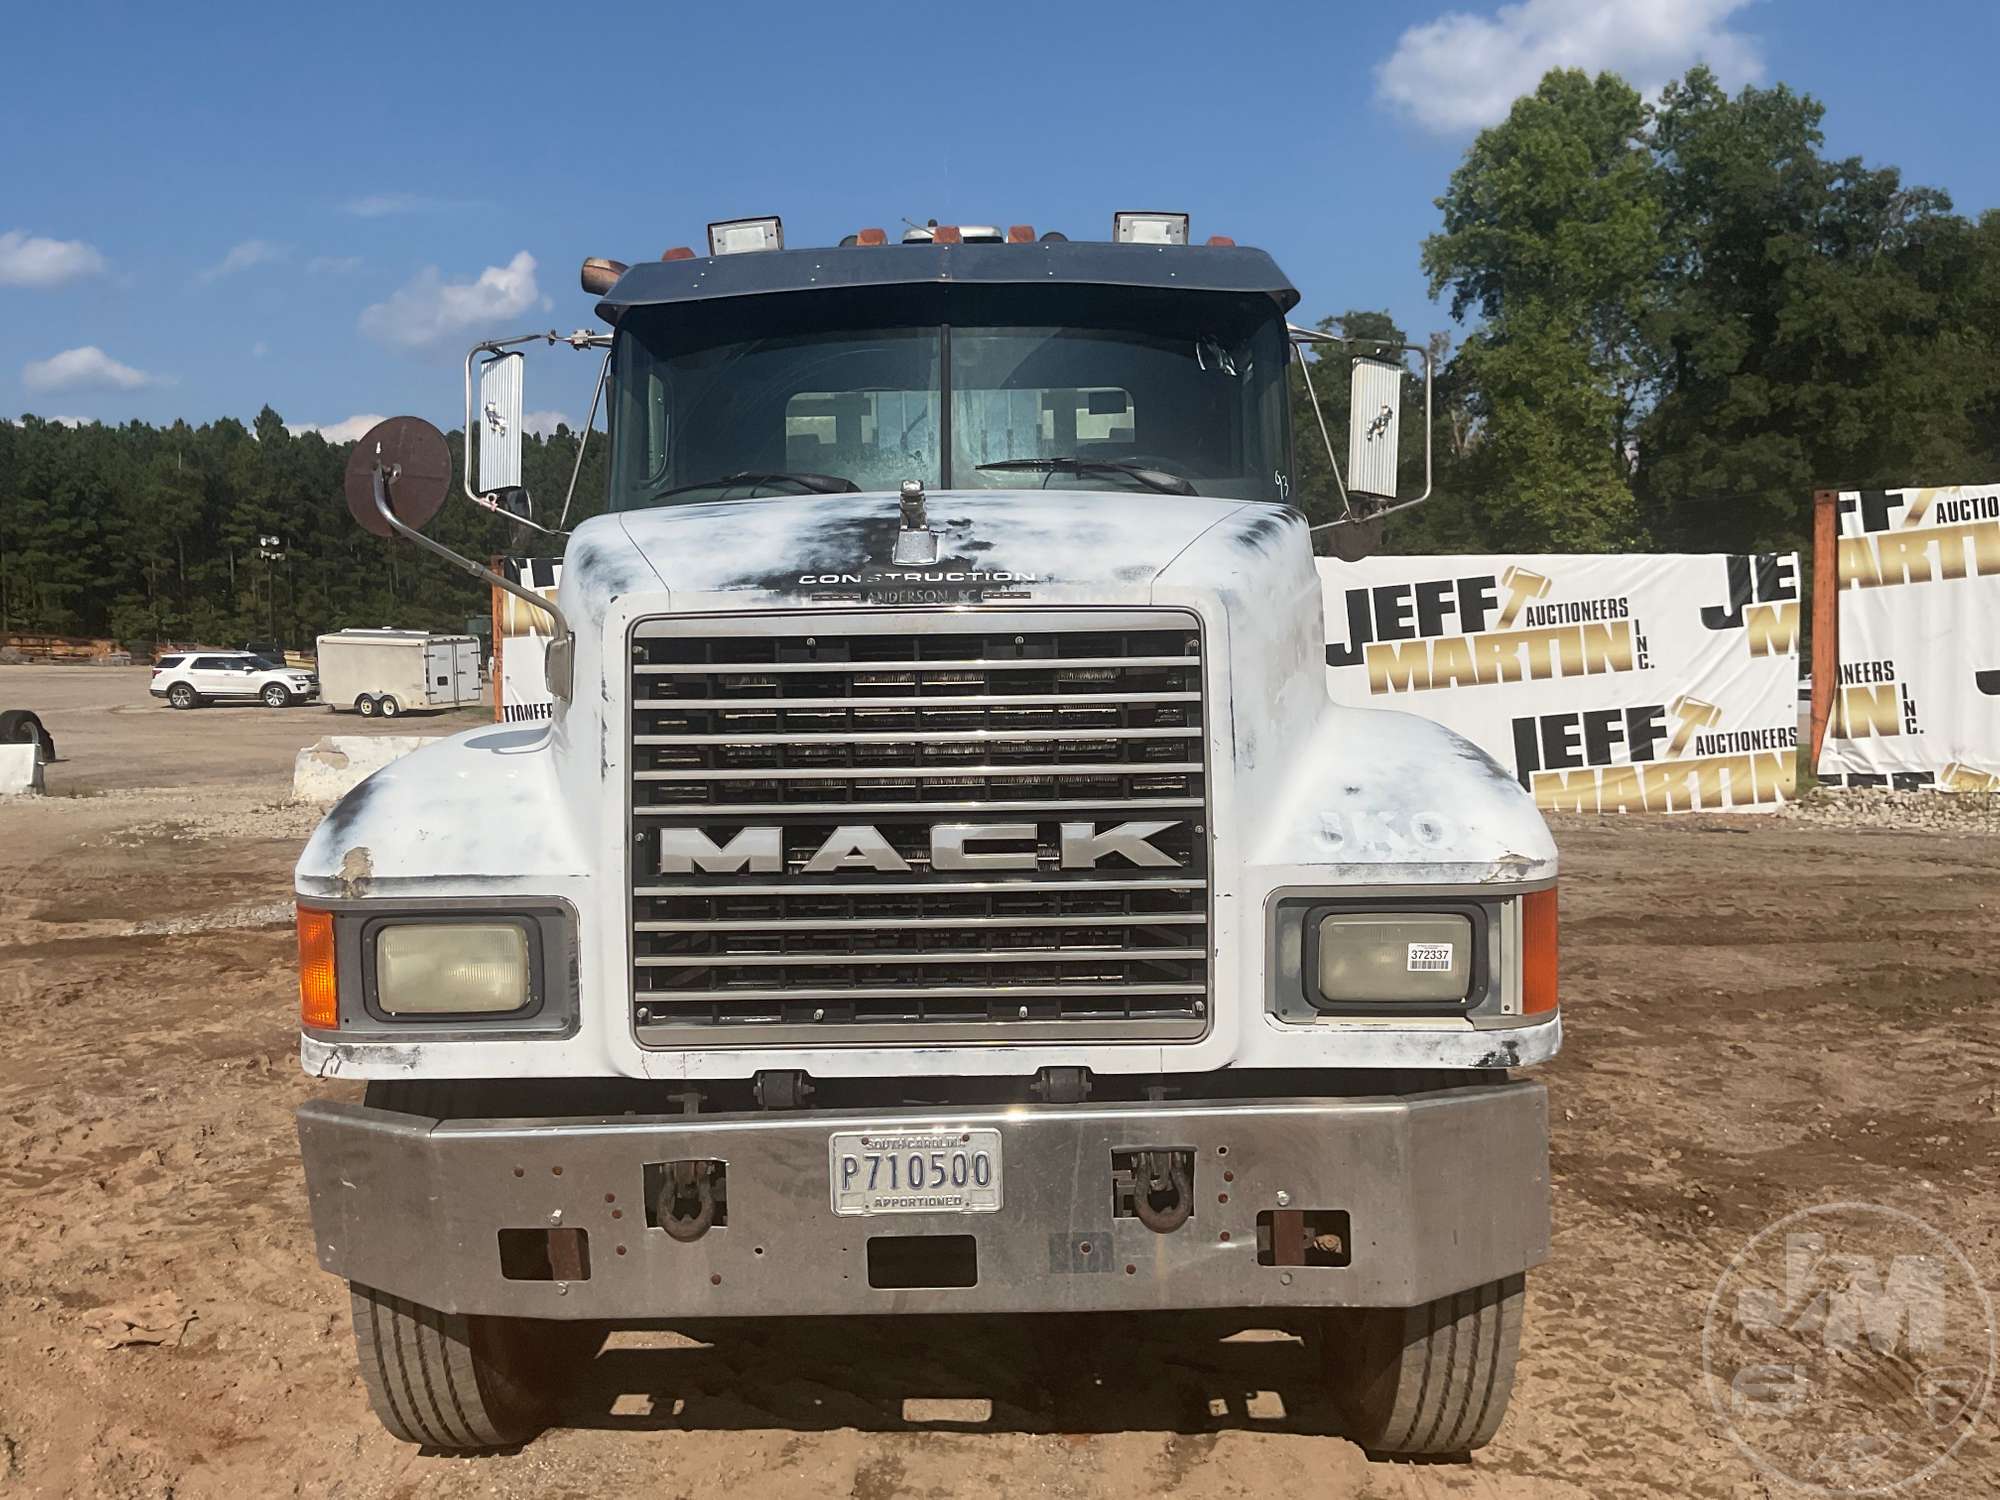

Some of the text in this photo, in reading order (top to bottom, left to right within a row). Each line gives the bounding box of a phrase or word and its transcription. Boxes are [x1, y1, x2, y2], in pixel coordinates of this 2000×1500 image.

[798, 571, 1036, 585] CONSTRUCTION
[1325, 575, 1629, 667] JEFF AUCTIONEERS
[1366, 620, 1633, 695] MARTIN
[1695, 727, 1798, 756] AUCTIONEERS
[1533, 751, 1797, 814] MARTIN
[659, 820, 1184, 874] MACK
[1411, 950, 1449, 960] 372337
[842, 1151, 991, 1190] P710500
[874, 1195, 962, 1208] APPORTIONED
